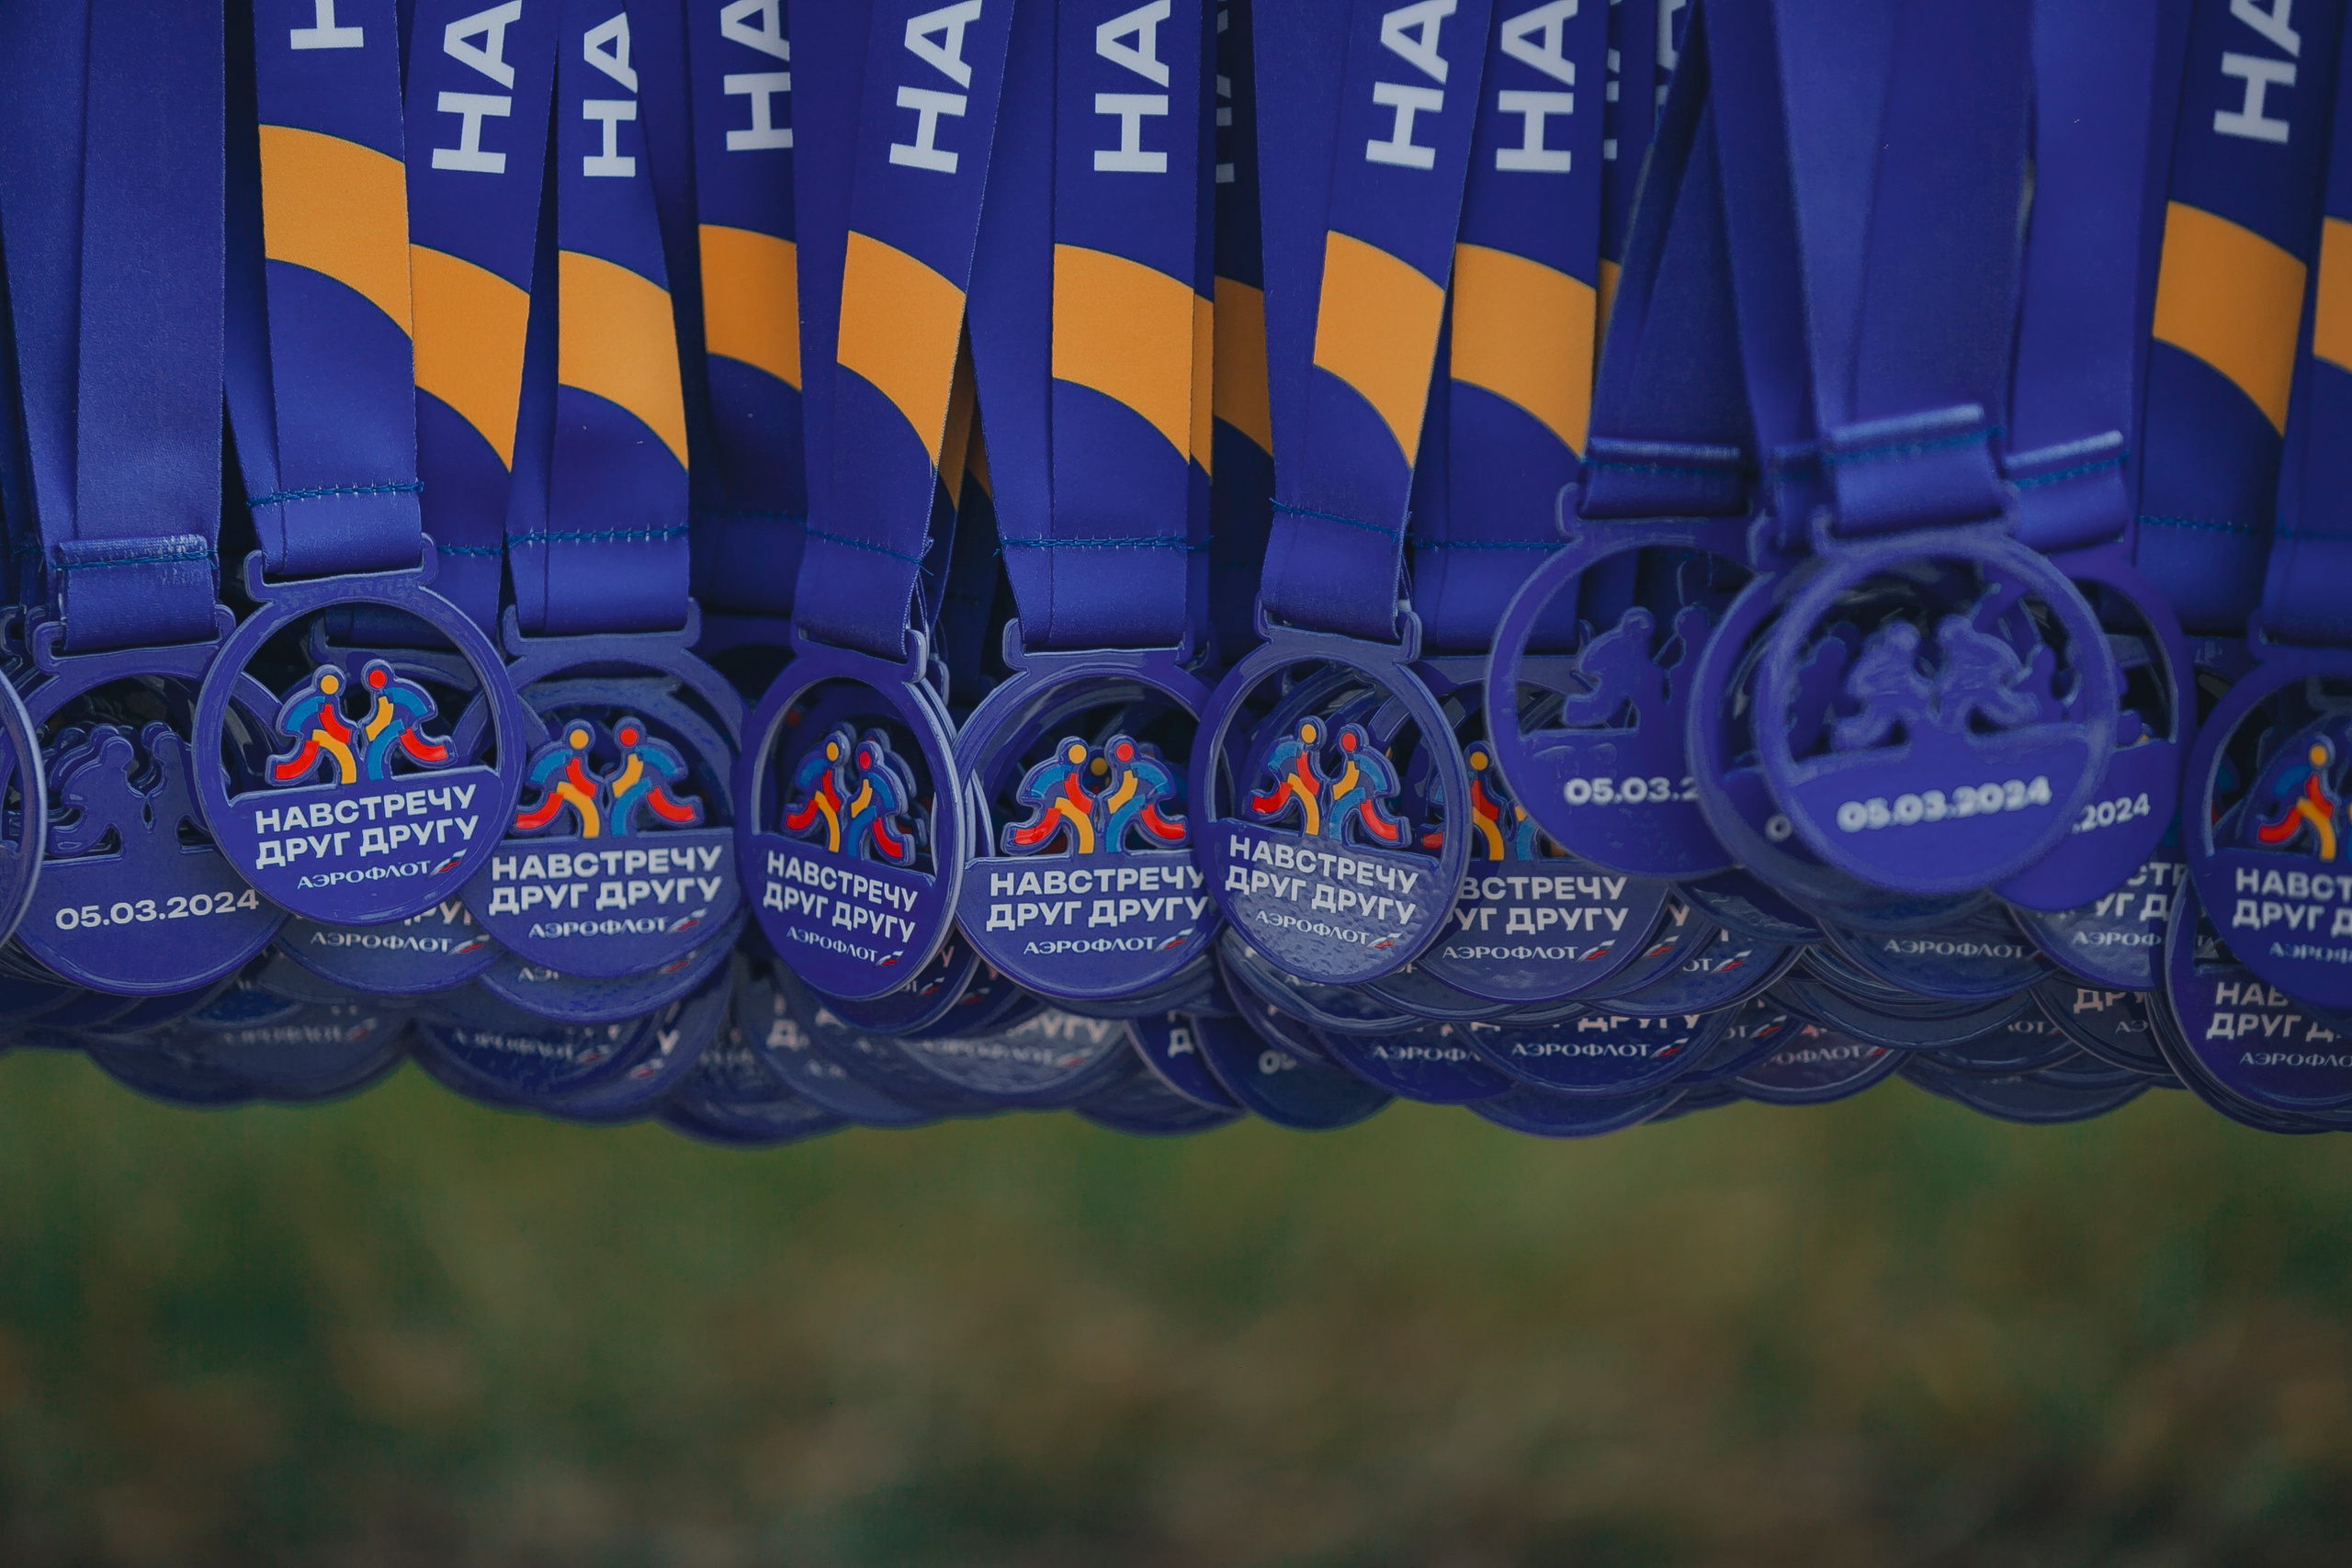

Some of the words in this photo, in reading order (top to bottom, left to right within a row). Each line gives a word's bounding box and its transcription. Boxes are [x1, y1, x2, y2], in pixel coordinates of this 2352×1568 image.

[1564, 776, 1700, 807] 05.03.2
[1836, 774, 2053, 833] 05.03.2024
[254, 784, 477, 834] НАВСТРЕЧУ
[2071, 792, 2151, 835] .2024
[255, 831, 351, 870] ДРУГ
[359, 815, 479, 857] ДРУГУ
[297, 860, 431, 889] АЭРОФЛОТ
[492, 845, 723, 881] НАВСТРЕЧУ
[1229, 834, 1419, 894] НАВСТРЕЧУ
[489, 883, 589, 916] ДРУГ
[595, 876, 722, 911] ДРУГУ
[766, 850, 918, 912] НАВСТРЕЧУ
[989, 865, 1204, 897] НАВСТРЕЧУ
[1225, 865, 1306, 896] ДРУГ
[1311, 883, 1417, 925] ДРУГУ
[1459, 876, 1627, 900] ВСТРЕЧУ
[55, 888, 259, 931] 05.03.2024
[763, 881, 829, 919] ДРУГ
[831, 900, 915, 943] ДРУГУ
[986, 900, 1082, 931] ДРУГ
[1088, 896, 1209, 928] ДРУГУ
[1448, 907, 1498, 931] УГ
[1506, 908, 1629, 935] ДРУГУ
[2231, 898, 2325, 932] ДРУГ
[311, 931, 454, 953] АЭРОФЛОТ
[528, 917, 668, 938] АЭРОФЛОТ
[1255, 909, 1369, 945] АЭРОФЛОТ
[2073, 931, 2162, 947] АЭРОФ
[786, 926, 878, 962] АЭРОФЛОТ
[1023, 936, 1158, 954] АЭРОФЛОТ
[1442, 946, 1578, 960] АЭРОФЛОТ
[1883, 939, 2026, 959] АЭРОФЛОТ
[2206, 1012, 2301, 1040] ДРУГ
[1364, 1044, 1481, 1062] АЭРОФЛ
[1511, 1043, 1651, 1058] АЭРОФЛОТ
[1763, 1045, 1864, 1066] ОФЛОТ
